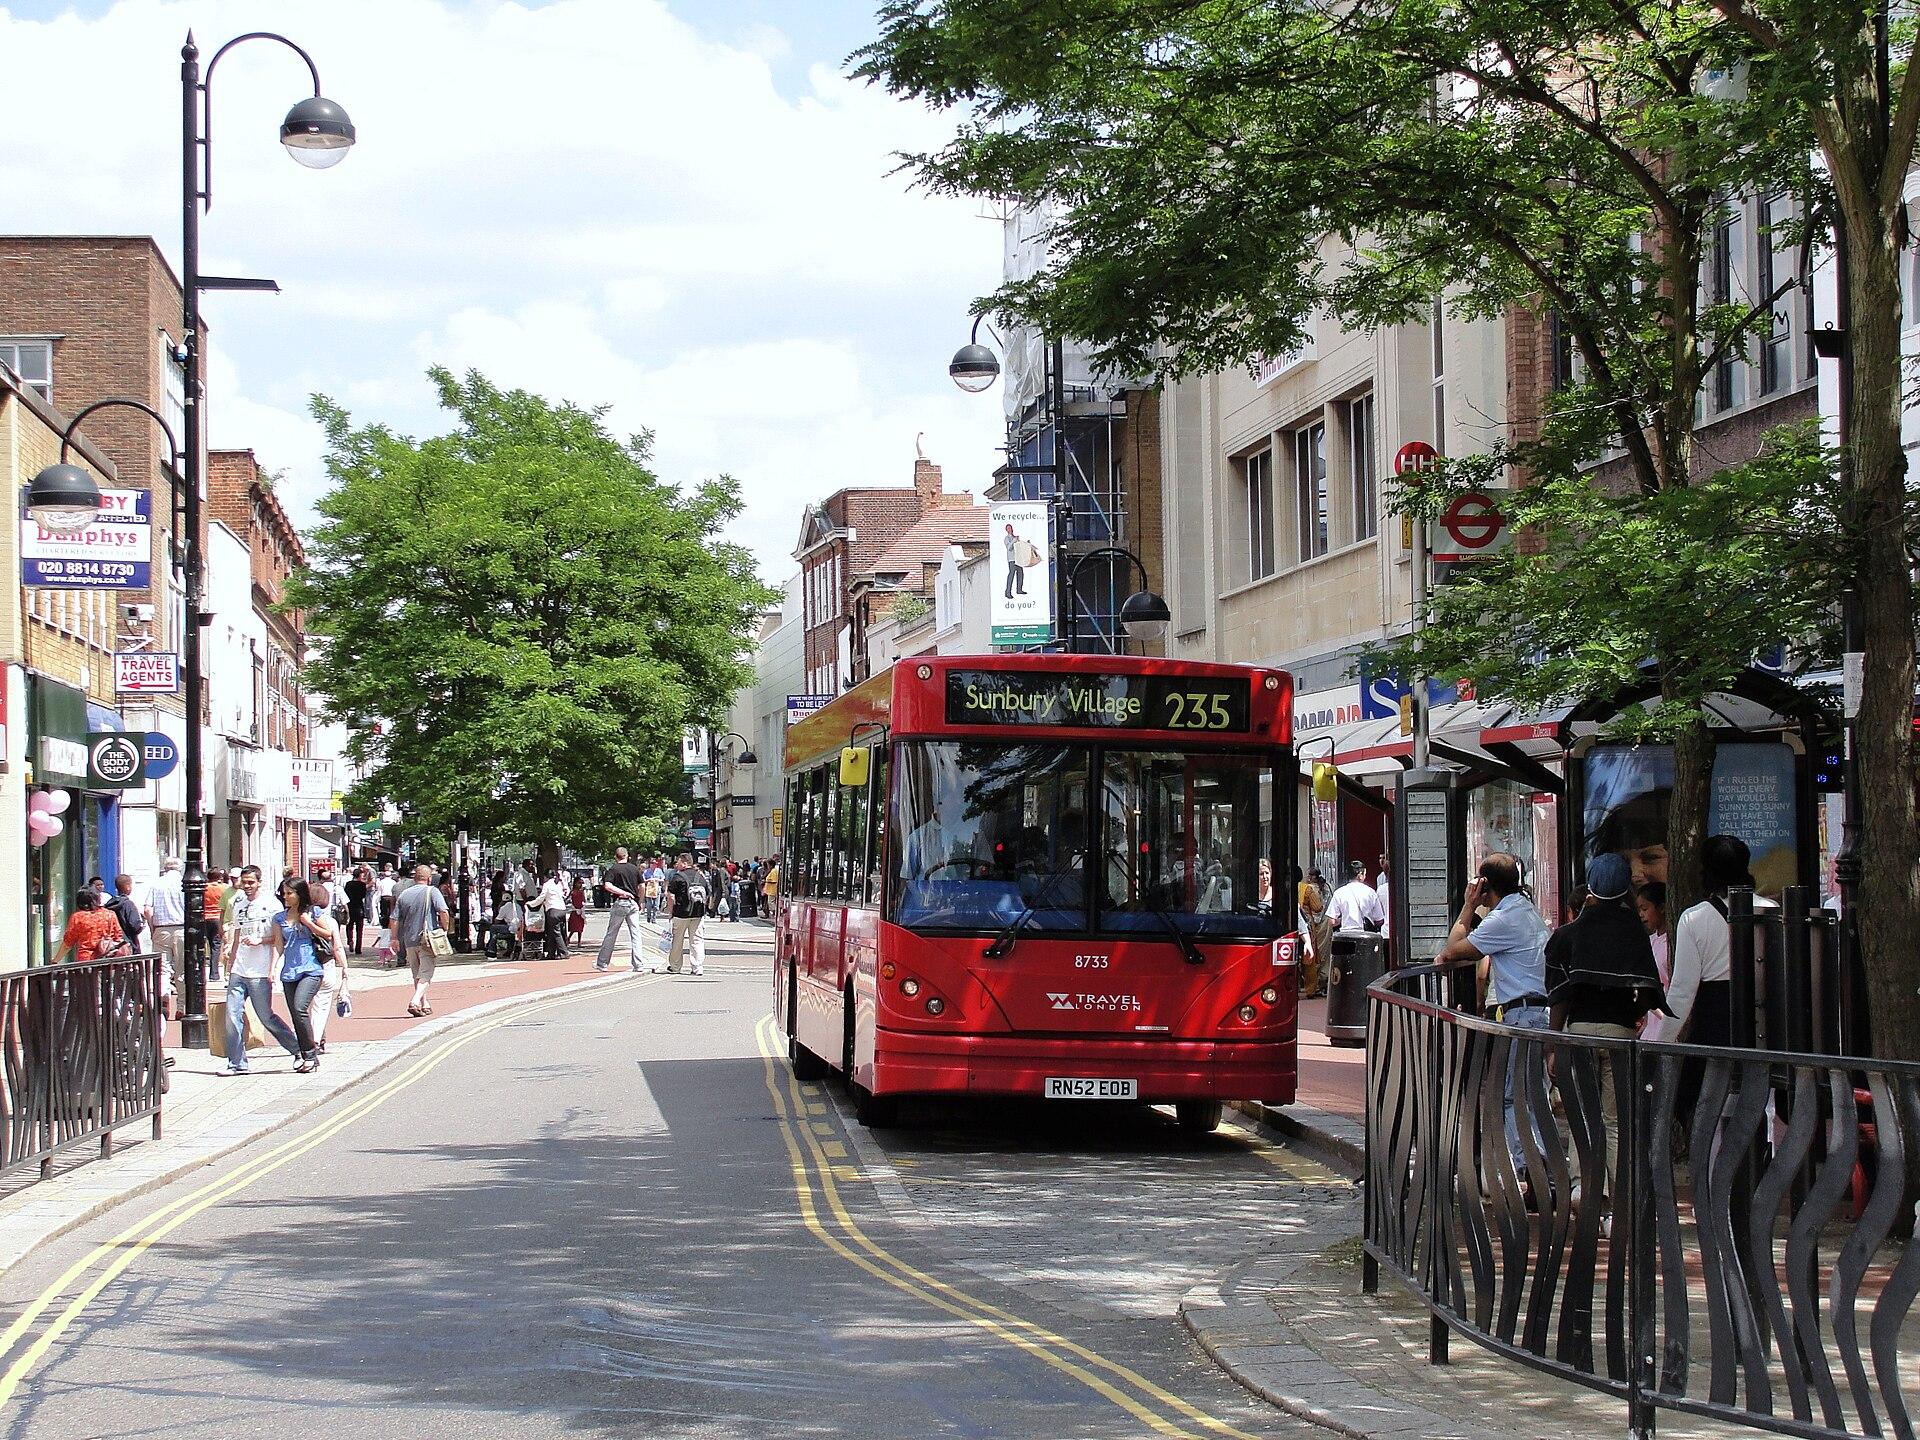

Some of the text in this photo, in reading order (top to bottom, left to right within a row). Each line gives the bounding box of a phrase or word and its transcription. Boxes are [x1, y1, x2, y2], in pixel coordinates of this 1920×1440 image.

[992, 512, 1005, 521] We
[38, 561, 135, 576] 020 8814 8730
[45, 575, 127, 585] www.dunphys.co.uk
[1005, 601, 1036, 611] do you?
[121, 660, 172, 670] TRAVEL
[120, 671, 173, 682] AGENTS
[965, 684, 1231, 729] Sunbury Village 235
[145, 746, 173, 760] EED
[103, 766, 130, 774] SHOP
[1732, 776, 1759, 784] RULED
[1761, 775, 1778, 784] THE
[1718, 784, 1776, 793] WORLD EVERY
[1718, 793, 1779, 803] DAY WOULD BE
[1749, 803, 1760, 811] SO
[1763, 802, 1791, 810] SUNNY
[1741, 811, 1762, 819] HAVE
[1764, 811, 1776, 819] TO
[1718, 820, 1779, 829] CALL HOME TO
[1753, 829, 1776, 838] THEM
[1778, 829, 1790, 837] ON
[1074, 955, 1108, 969] 8733
[1075, 993, 1141, 1005] TRAVEL
[1075, 1003, 1141, 1011] LONDON
[1052, 1079, 1131, 1096] RN52 EOB
